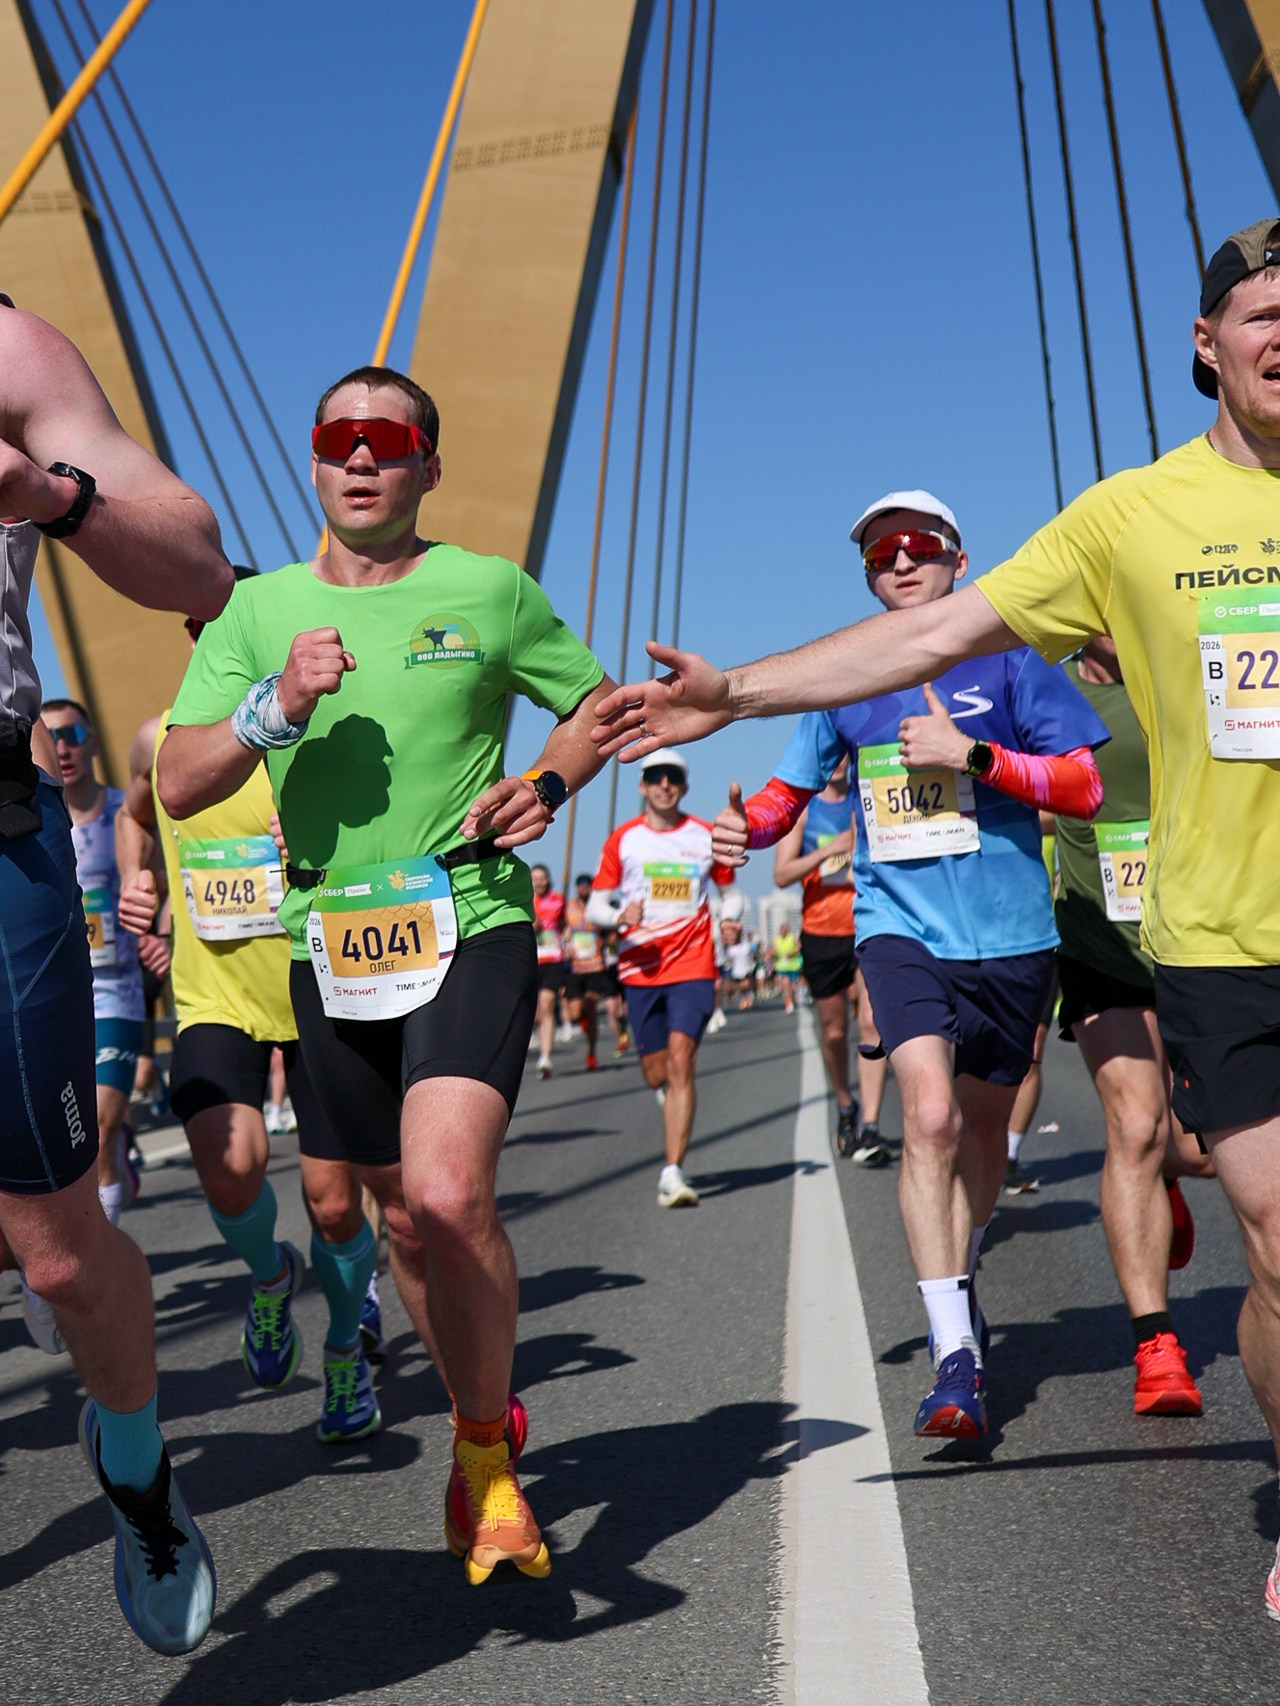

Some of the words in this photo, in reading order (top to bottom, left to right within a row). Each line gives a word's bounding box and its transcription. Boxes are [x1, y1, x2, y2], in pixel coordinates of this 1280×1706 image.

[1228, 606, 1257, 616] СБЕР
[1201, 642, 1221, 650] 2026
[1237, 720, 1280, 729] МАГНИТ
[887, 782, 944, 814] 5042
[204, 879, 256, 906] 4948
[323, 888, 344, 897] СБЕР
[213, 906, 249, 916] НИКОЛАЙ
[342, 920, 422, 962] 4041
[369, 960, 396, 974] ОЛЕГ
[343, 987, 378, 996] МАГНИТ
